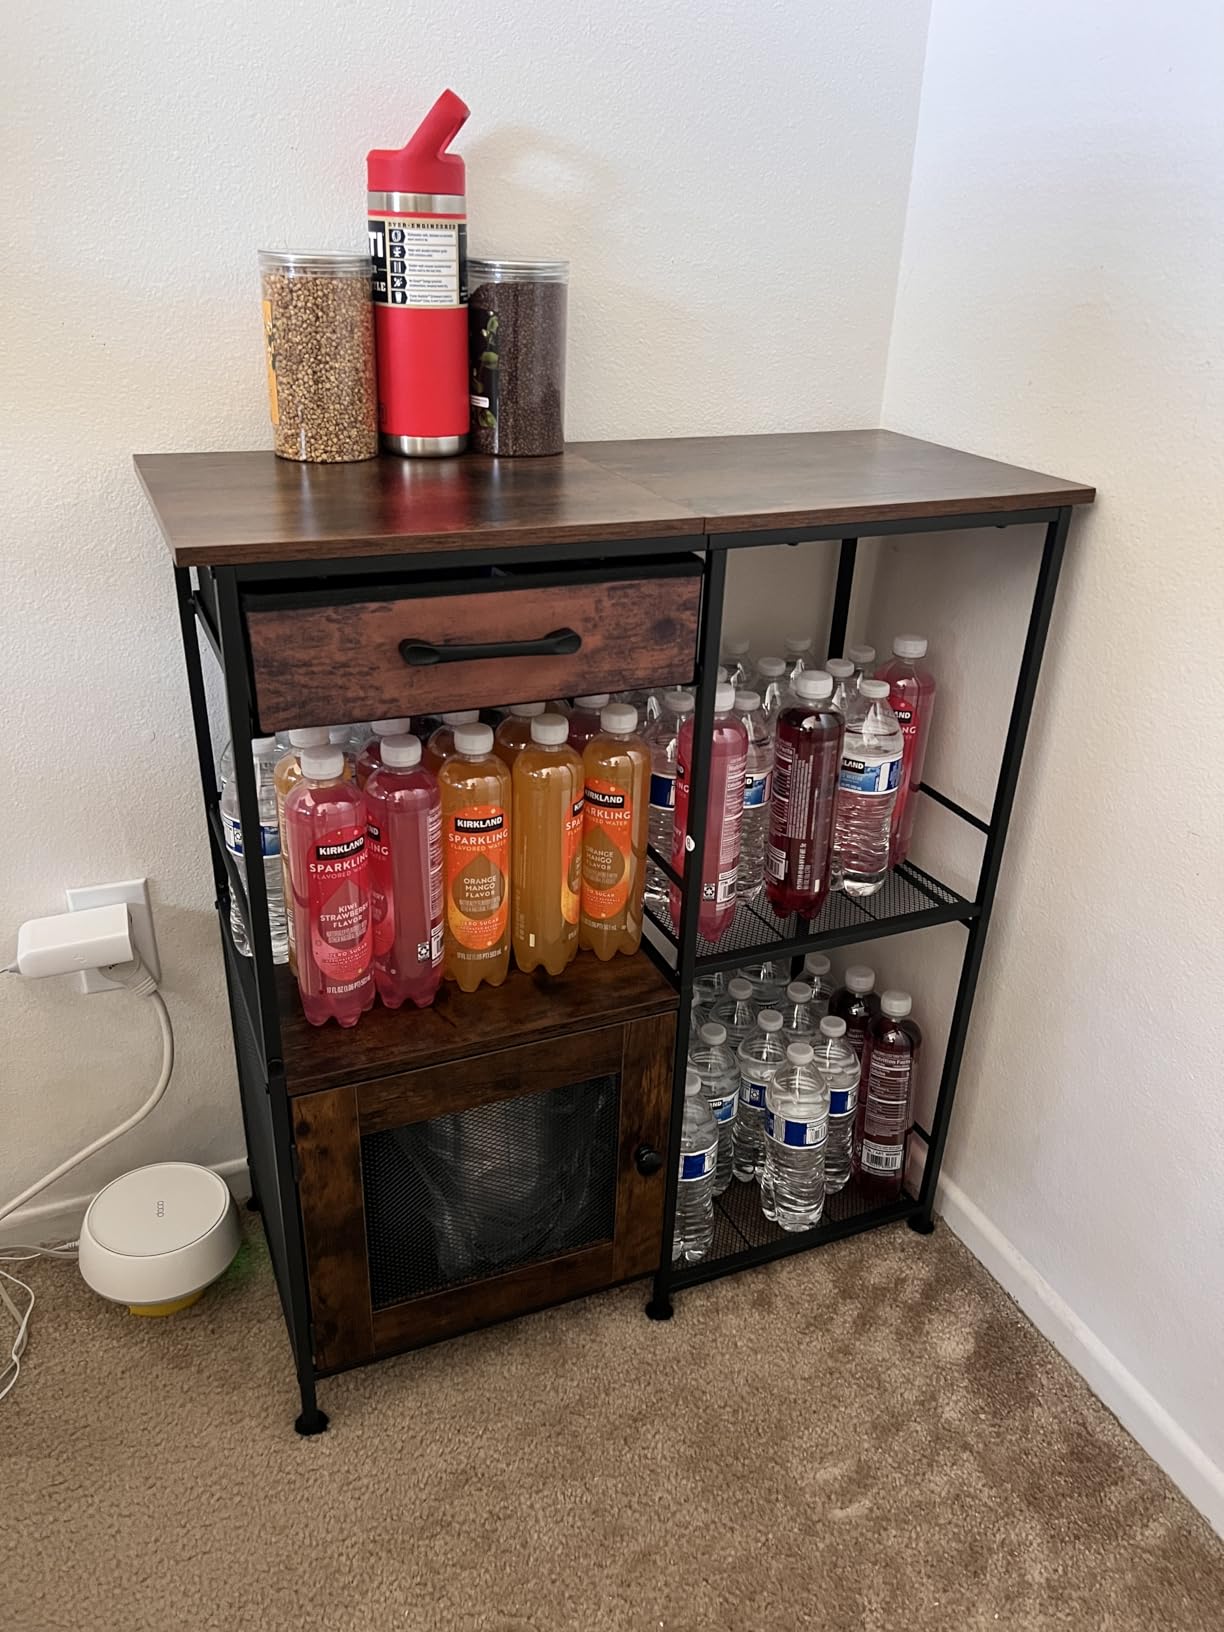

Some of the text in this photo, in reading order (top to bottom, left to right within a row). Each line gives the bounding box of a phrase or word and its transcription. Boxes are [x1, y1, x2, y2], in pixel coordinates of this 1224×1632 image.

[368, 231, 384, 258] TI
[843, 760, 864, 770] LAND
[457, 816, 503, 828] KIRKLAND
[448, 829, 508, 846] SPARKLING
[319, 837, 364, 856] KIRKLAND
[463, 875, 497, 885] ORANGE
[465, 882, 496, 892] MANGO
[465, 889, 495, 898] FLAVOR
[320, 901, 369, 922] STRAWBERRY
[338, 902, 357, 913] KIWI
[333, 914, 363, 928] FLAVOR
